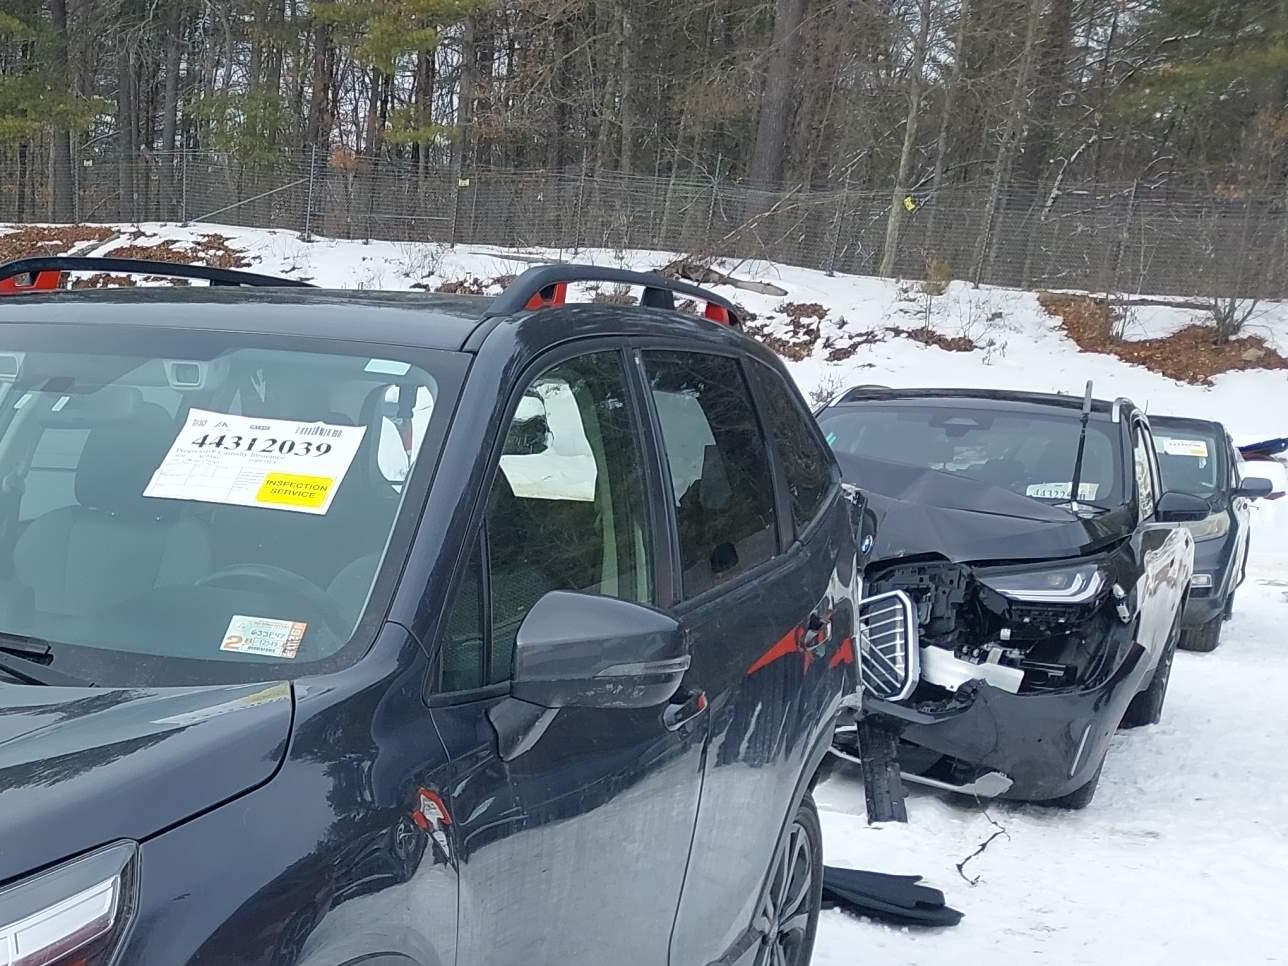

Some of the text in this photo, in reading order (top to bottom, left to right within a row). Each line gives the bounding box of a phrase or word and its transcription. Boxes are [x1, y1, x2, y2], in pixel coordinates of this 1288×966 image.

[191, 433, 332, 458] 44312039
[266, 479, 329, 492] INSPECTION
[270, 488, 317, 498] SERVICE
[223, 634, 243, 650] 2
